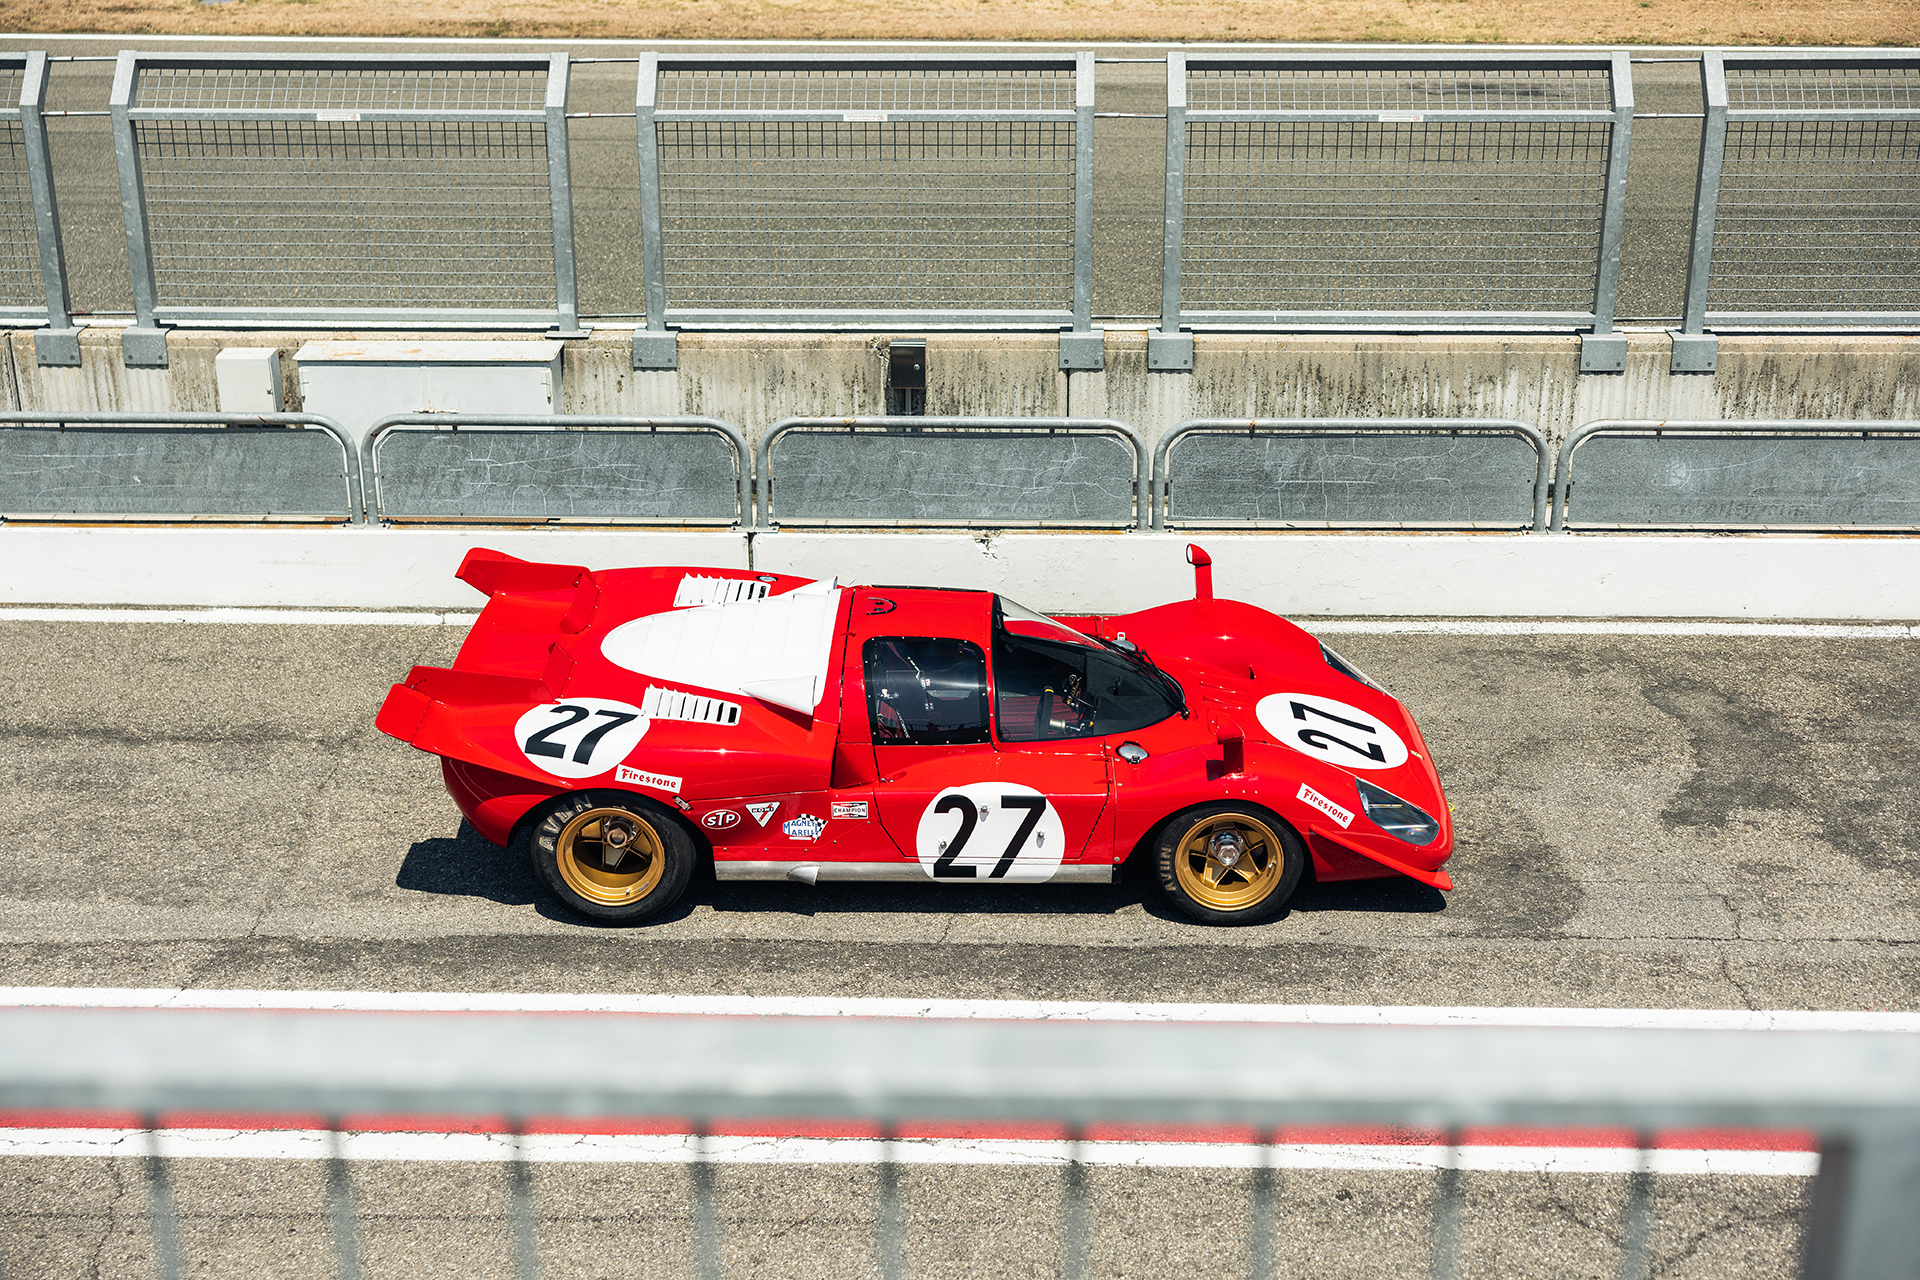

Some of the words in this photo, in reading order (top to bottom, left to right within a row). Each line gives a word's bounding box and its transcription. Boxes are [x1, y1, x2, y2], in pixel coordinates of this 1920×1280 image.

[525, 705, 639, 765] 27
[1289, 700, 1387, 763] 27
[621, 768, 677, 789] Firestone
[707, 811, 736, 827] STP
[1302, 788, 1349, 823] Firestone
[933, 794, 1047, 878] 27
